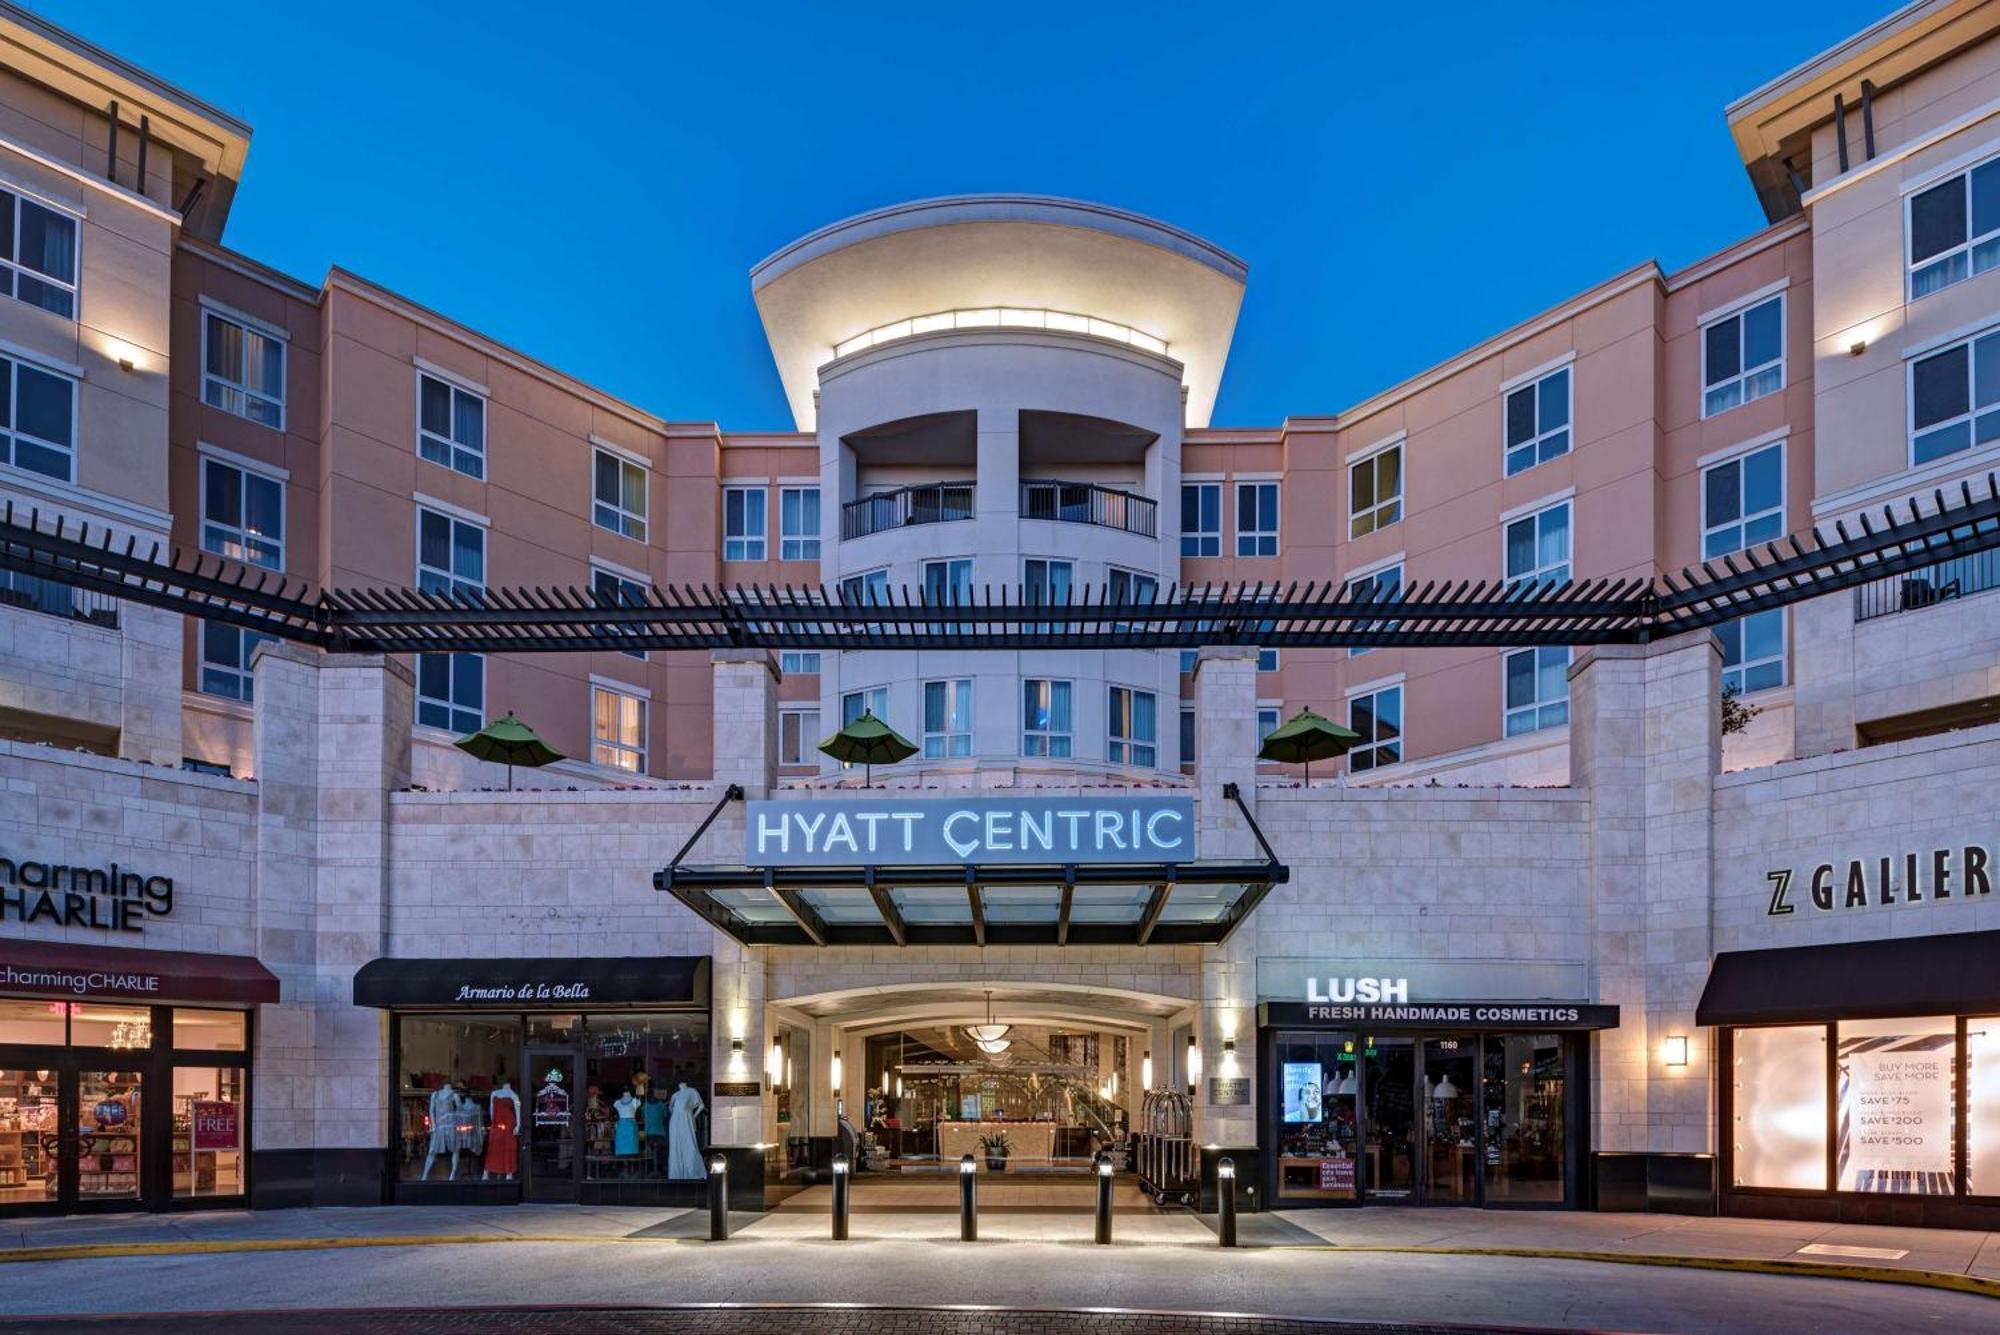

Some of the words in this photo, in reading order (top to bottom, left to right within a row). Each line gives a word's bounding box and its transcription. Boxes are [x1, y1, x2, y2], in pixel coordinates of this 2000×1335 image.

[758, 812, 924, 852] HYATT
[943, 810, 1182, 858] CENTRIC
[1767, 869, 1794, 915] Z
[1811, 846, 1990, 910] GALLER
[455, 985, 514, 1000] Armario
[518, 984, 533, 998] de
[537, 984, 550, 998] la
[553, 983, 589, 998] Bella
[1307, 978, 1407, 1003] LUSH
[1308, 1007, 1365, 1019] FRESH
[1371, 1007, 1470, 1021] HANDMADE
[1476, 1008, 1579, 1021] COSMETICS
[1440, 1041, 1458, 1050] 1160
[1879, 1062, 1901, 1071] BUY
[1905, 1062, 1939, 1070] MORE
[1874, 1072, 1902, 1080] SAVE
[1905, 1072, 1939, 1080] MORE
[1860, 1097, 1888, 1105] SAVE
[199, 1118, 234, 1132] FREE
[1860, 1117, 1888, 1125] SAVE
[1860, 1136, 1888, 1145] SAVE
